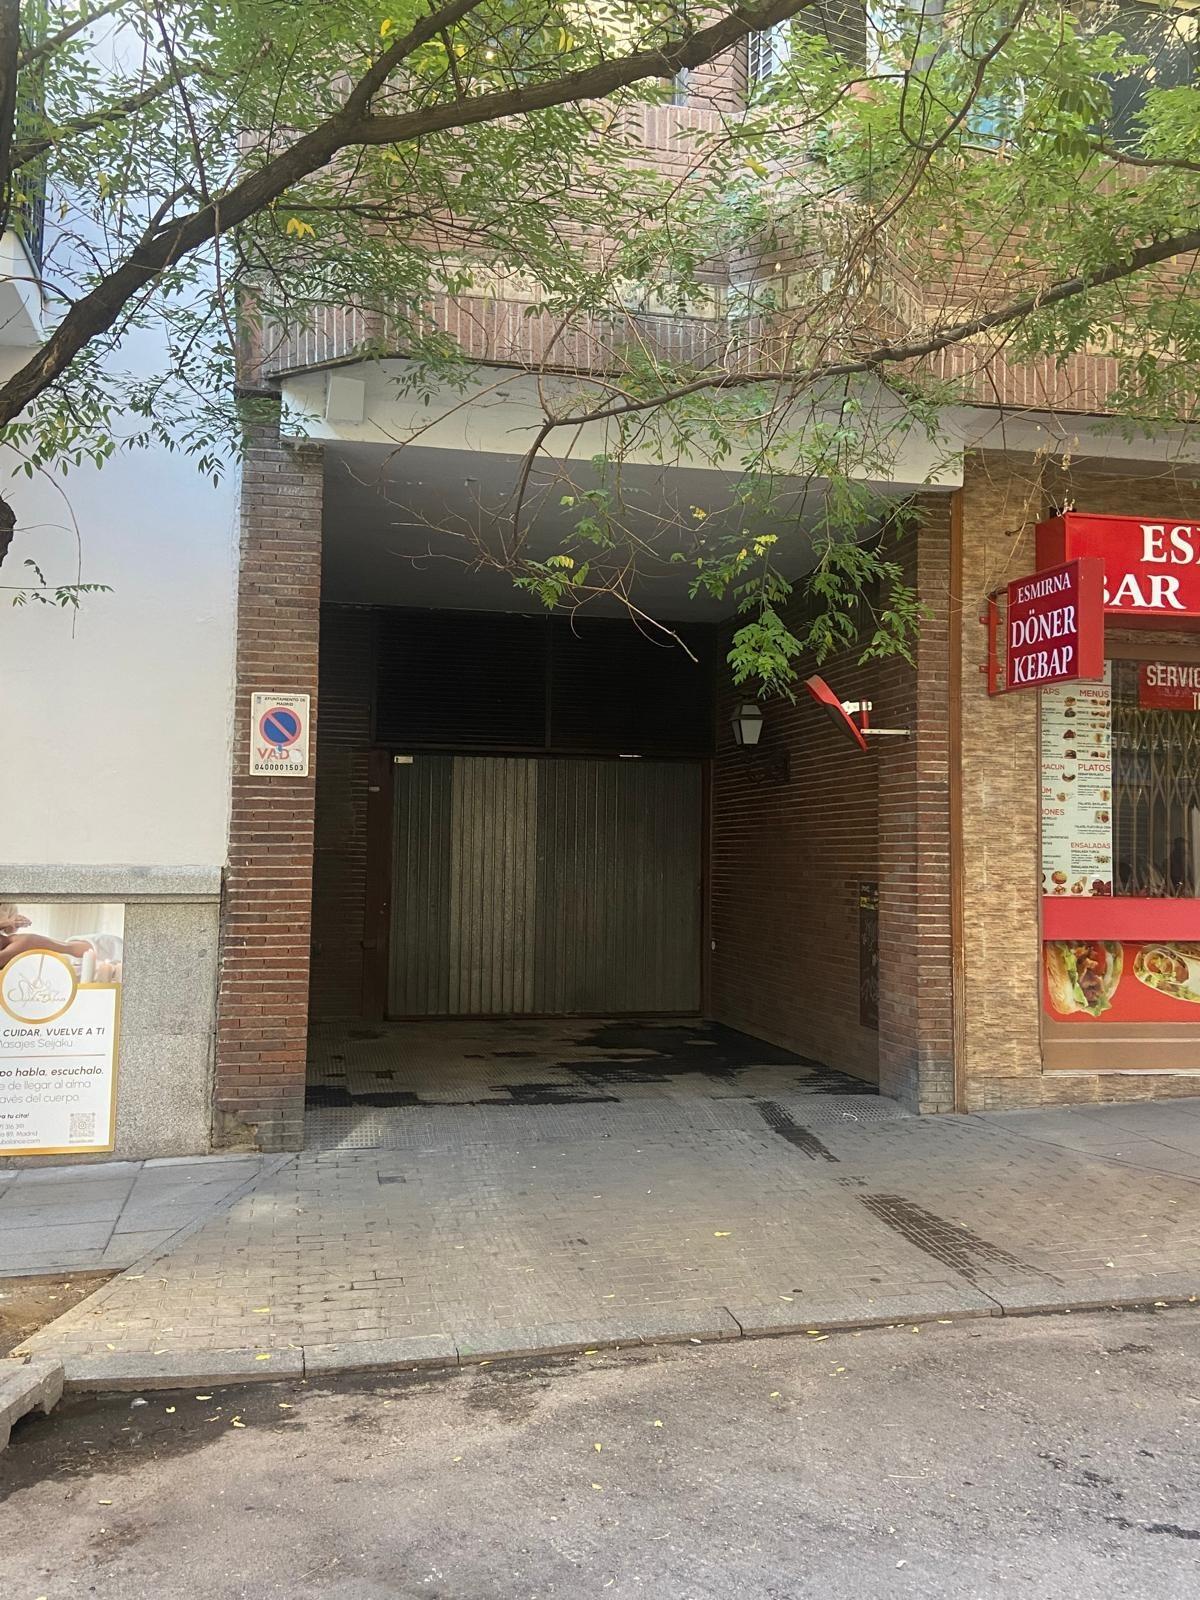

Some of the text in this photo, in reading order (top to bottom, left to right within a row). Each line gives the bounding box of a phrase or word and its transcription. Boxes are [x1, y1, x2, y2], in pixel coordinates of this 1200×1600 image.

[1139, 524, 1200, 564] ES
[1017, 572, 1072, 603] ESMIRNA
[1011, 605, 1077, 648] DÖNER
[1013, 645, 1073, 683] KEBAP
[257, 747, 303, 761] VAD
[254, 763, 304, 771] 0400001503
[1078, 763, 1111, 772] PLATOS
[1070, 842, 1111, 850] ENSALADAS
[46, 1028, 83, 1036] VUELVE
[96, 1027, 105, 1035] TI
[8, 1081, 21, 1090] de
[24, 1081, 51, 1092] llegar
[54, 1080, 63, 1089] al
[65, 1079, 91, 1089] alma
[26, 1093, 42, 1103] del
[44, 1094, 79, 1104] cuerpo
